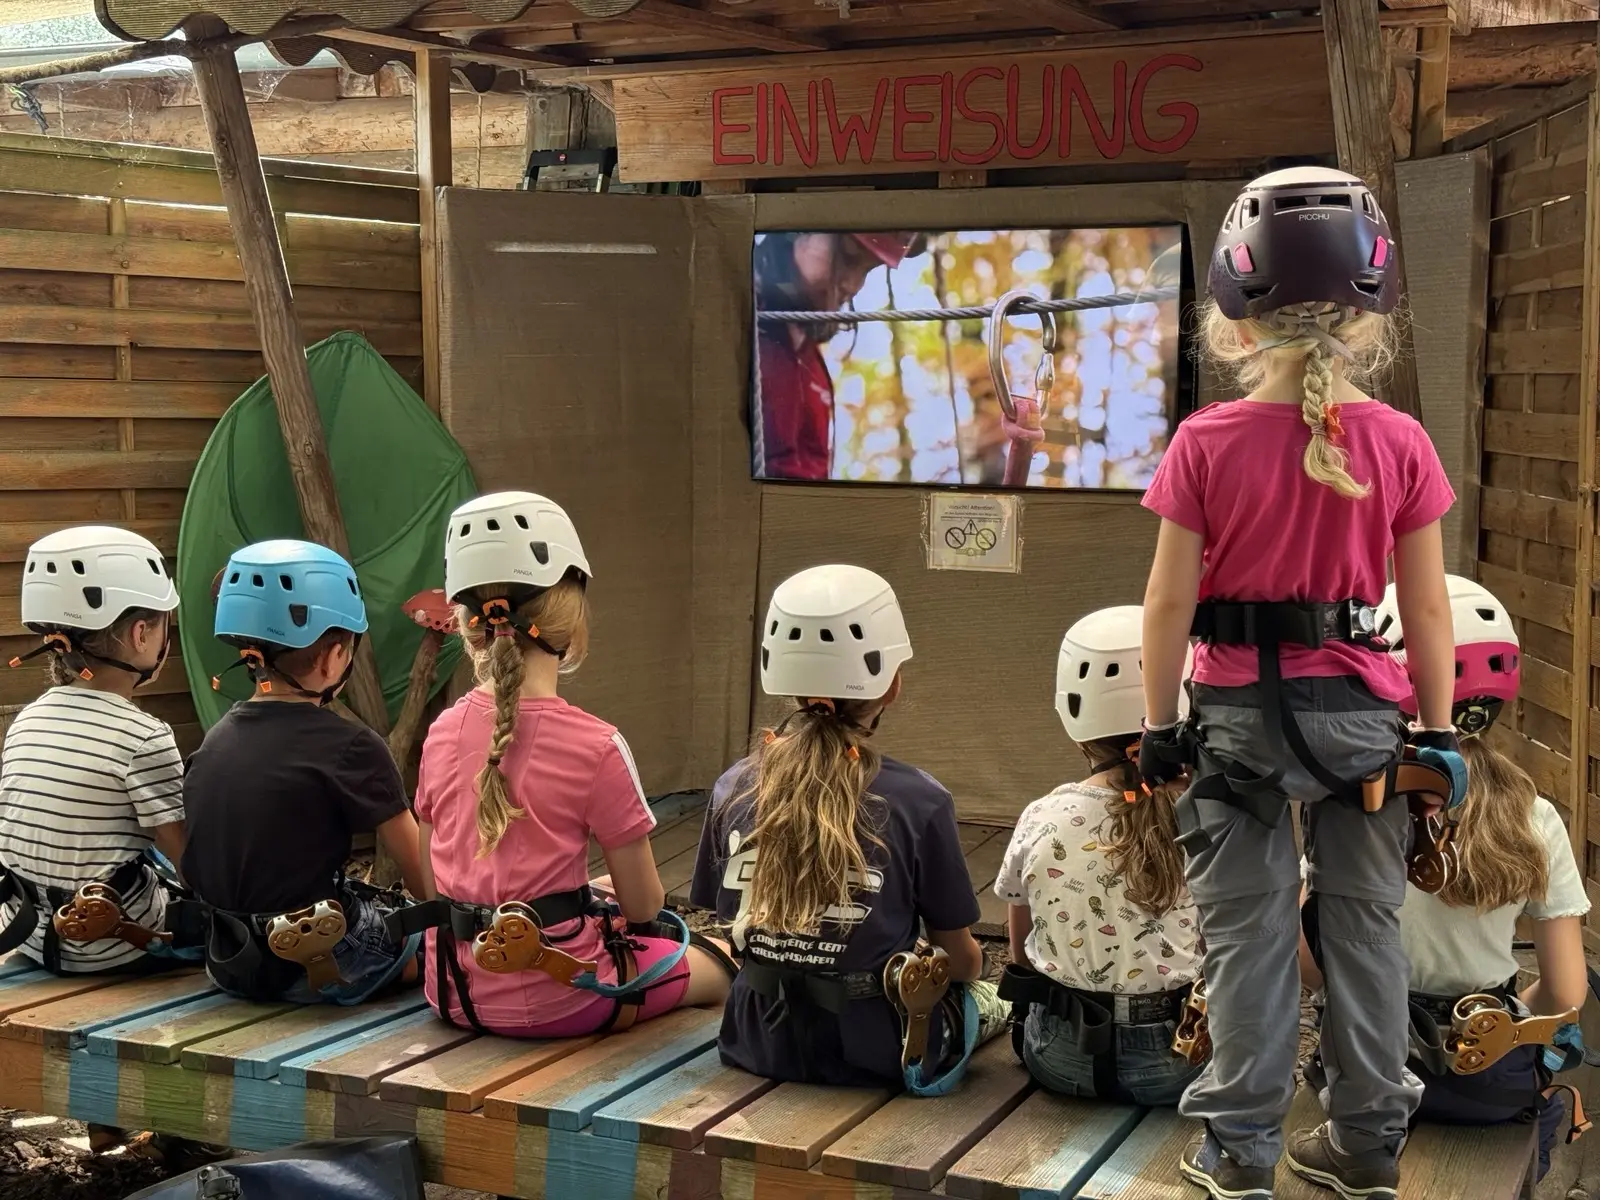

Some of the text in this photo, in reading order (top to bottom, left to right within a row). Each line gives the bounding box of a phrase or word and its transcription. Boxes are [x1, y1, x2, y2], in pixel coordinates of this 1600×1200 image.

[712, 54, 1203, 169] EINWEISUNG
[1298, 213, 1330, 222] PICCHU
[63, 611, 82, 620] PANGA
